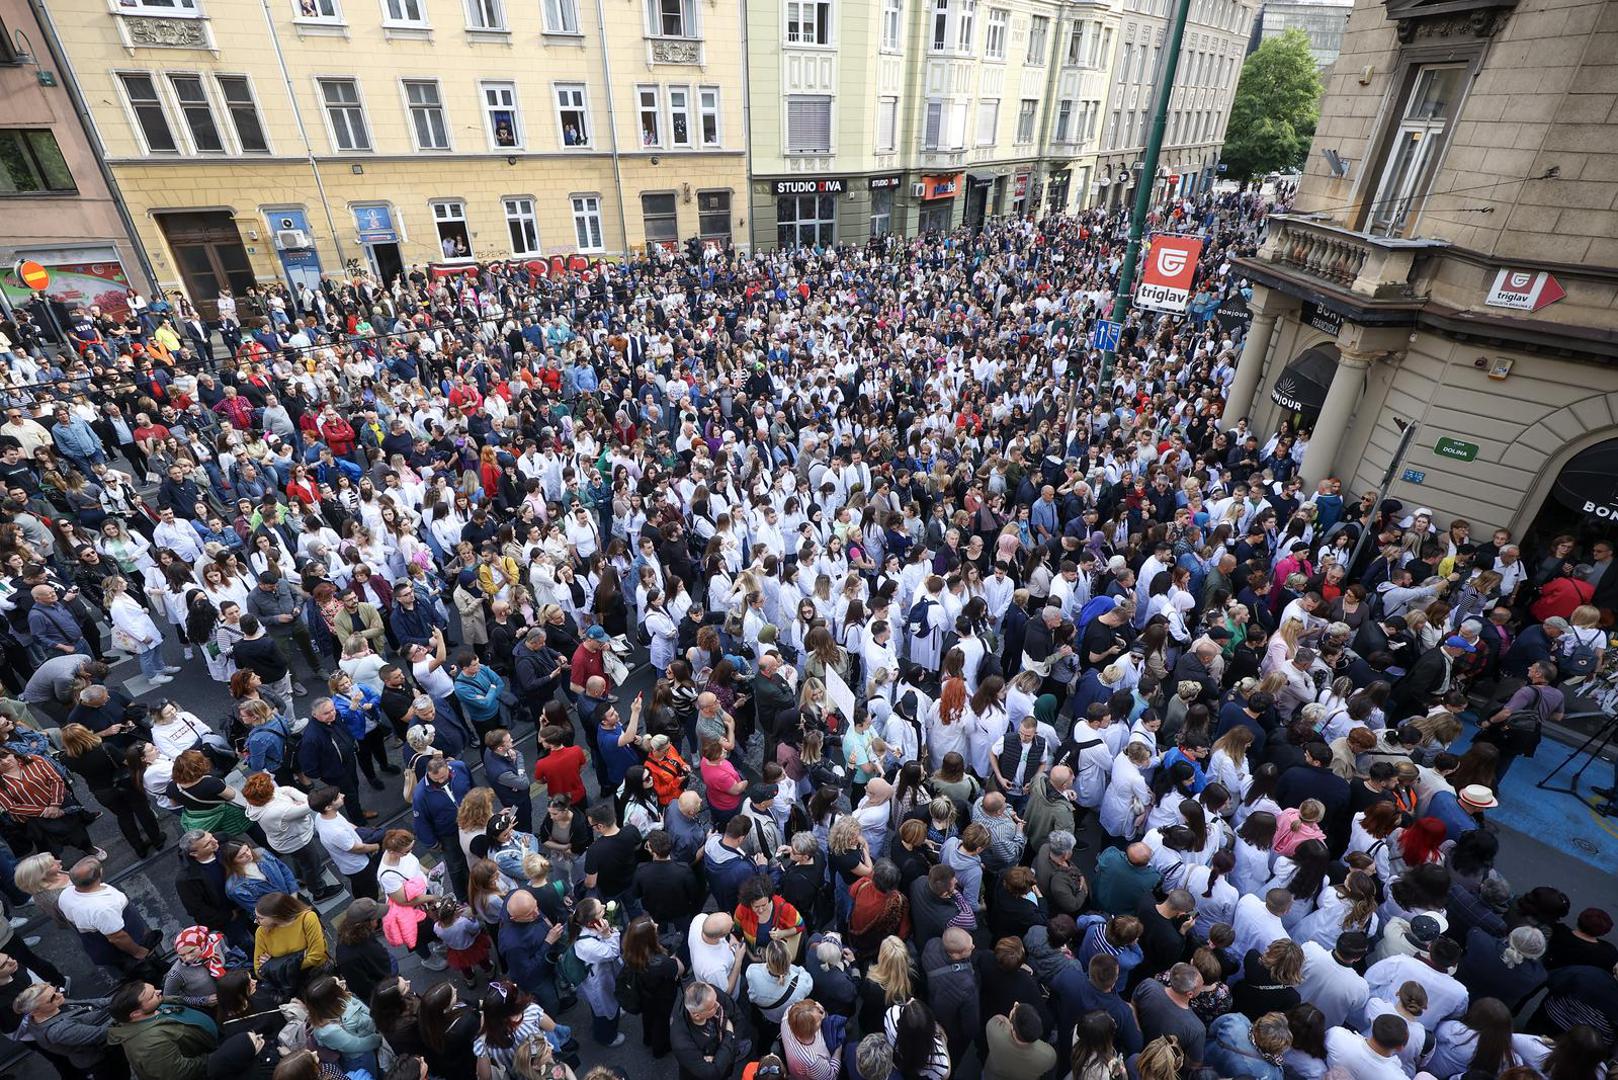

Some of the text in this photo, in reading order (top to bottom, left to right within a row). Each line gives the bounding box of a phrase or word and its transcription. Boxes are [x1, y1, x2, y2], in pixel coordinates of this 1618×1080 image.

[778, 181, 841, 192] STUDIO DIVA
[872, 179, 888, 187] STUDIO
[1142, 286, 1186, 303] triglav
[1497, 292, 1528, 302] triglav
[1217, 308, 1249, 318] BONJOUR
[1442, 446, 1468, 457] DOLINA
